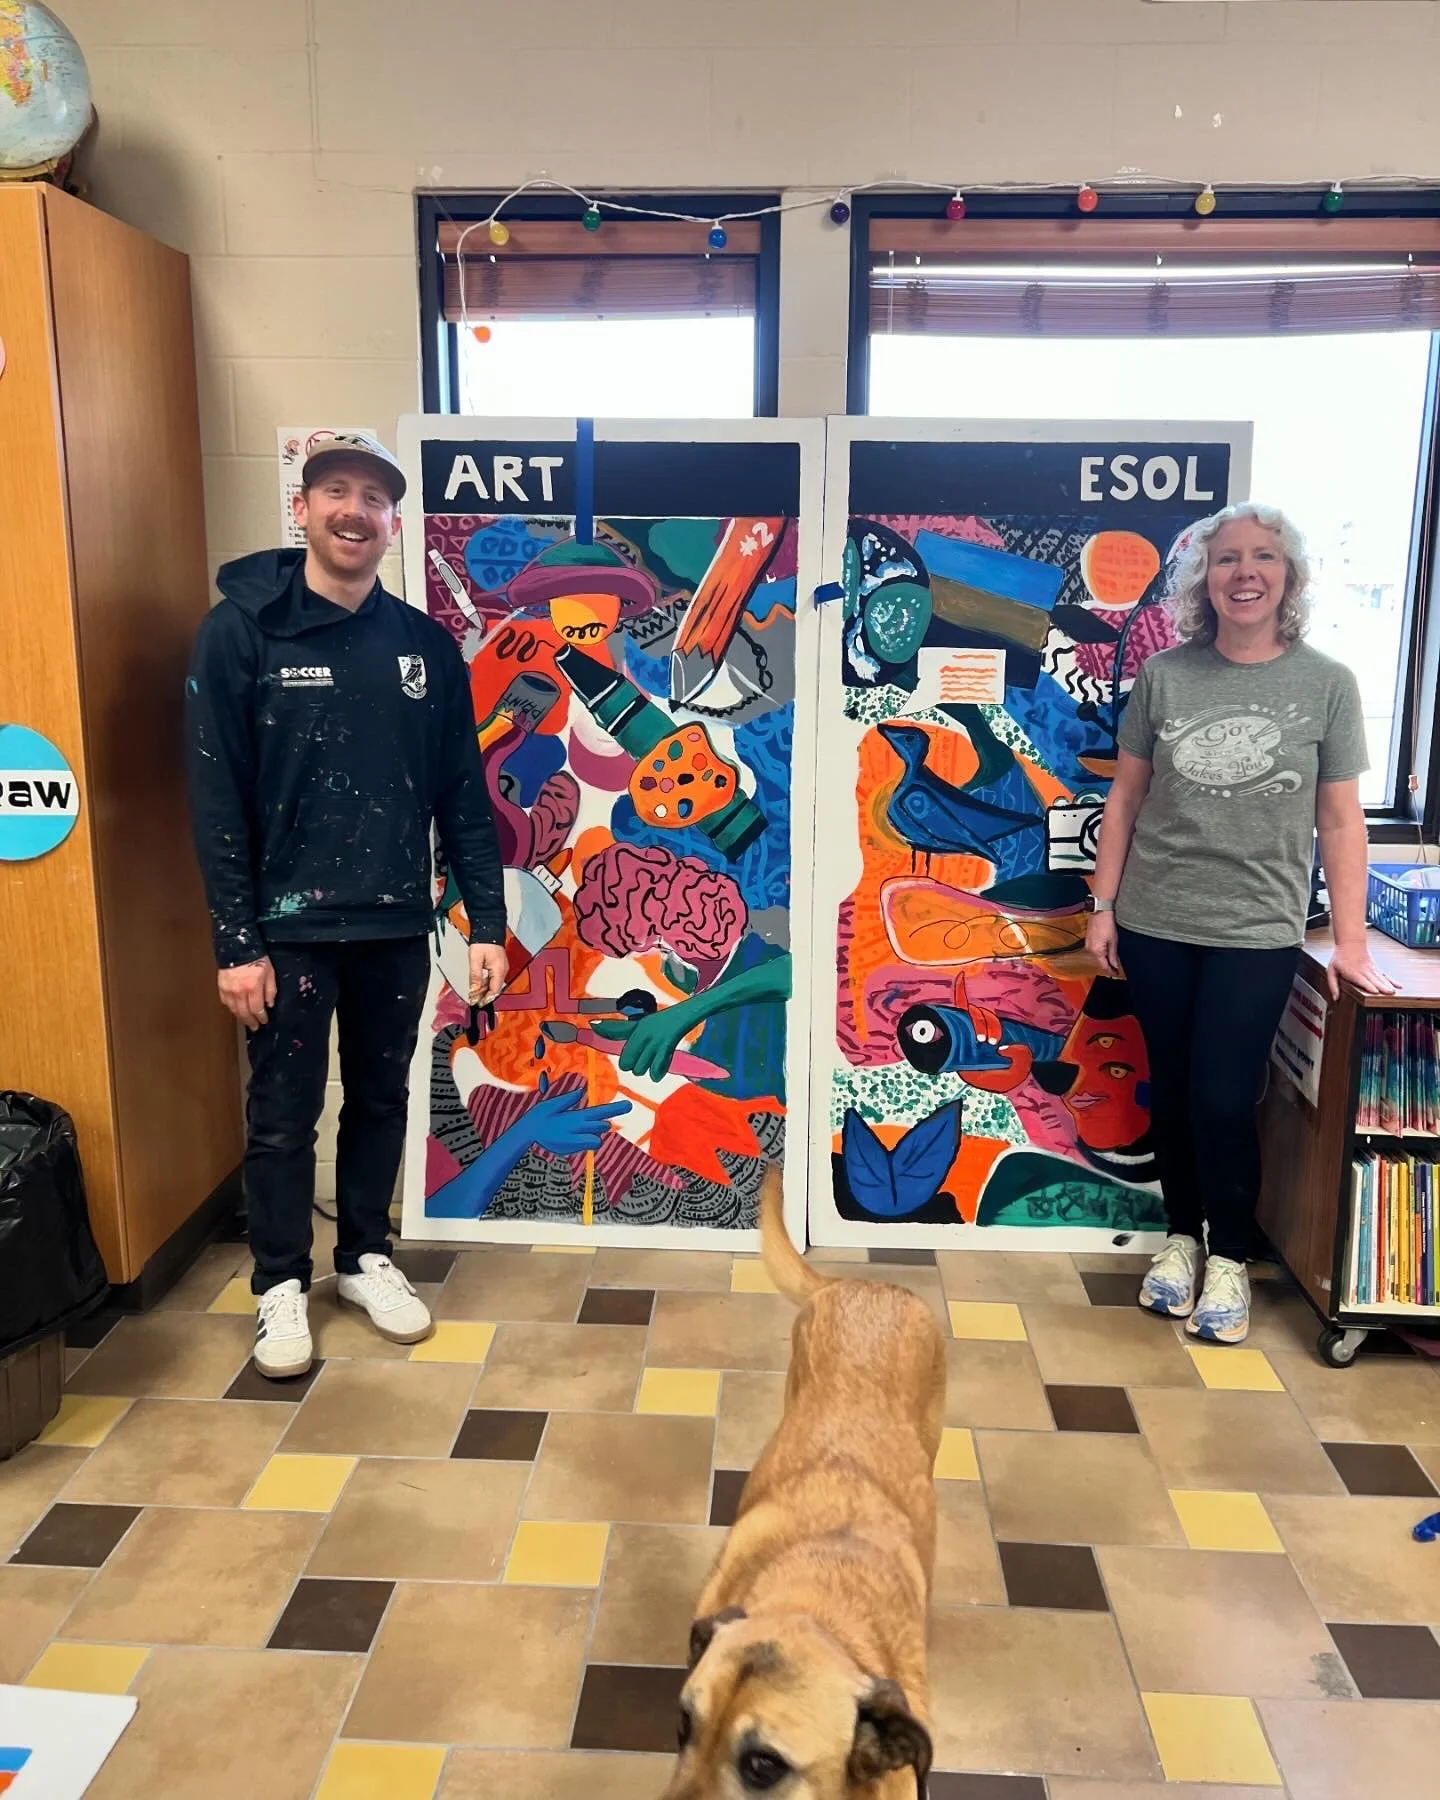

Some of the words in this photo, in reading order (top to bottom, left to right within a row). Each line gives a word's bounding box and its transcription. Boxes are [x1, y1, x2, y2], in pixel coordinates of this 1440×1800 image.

[444, 455, 563, 501] ART
[1080, 455, 1213, 502] ESOL
[280, 667, 332, 678] SOCCER
[503, 692, 546, 720] PAINT
